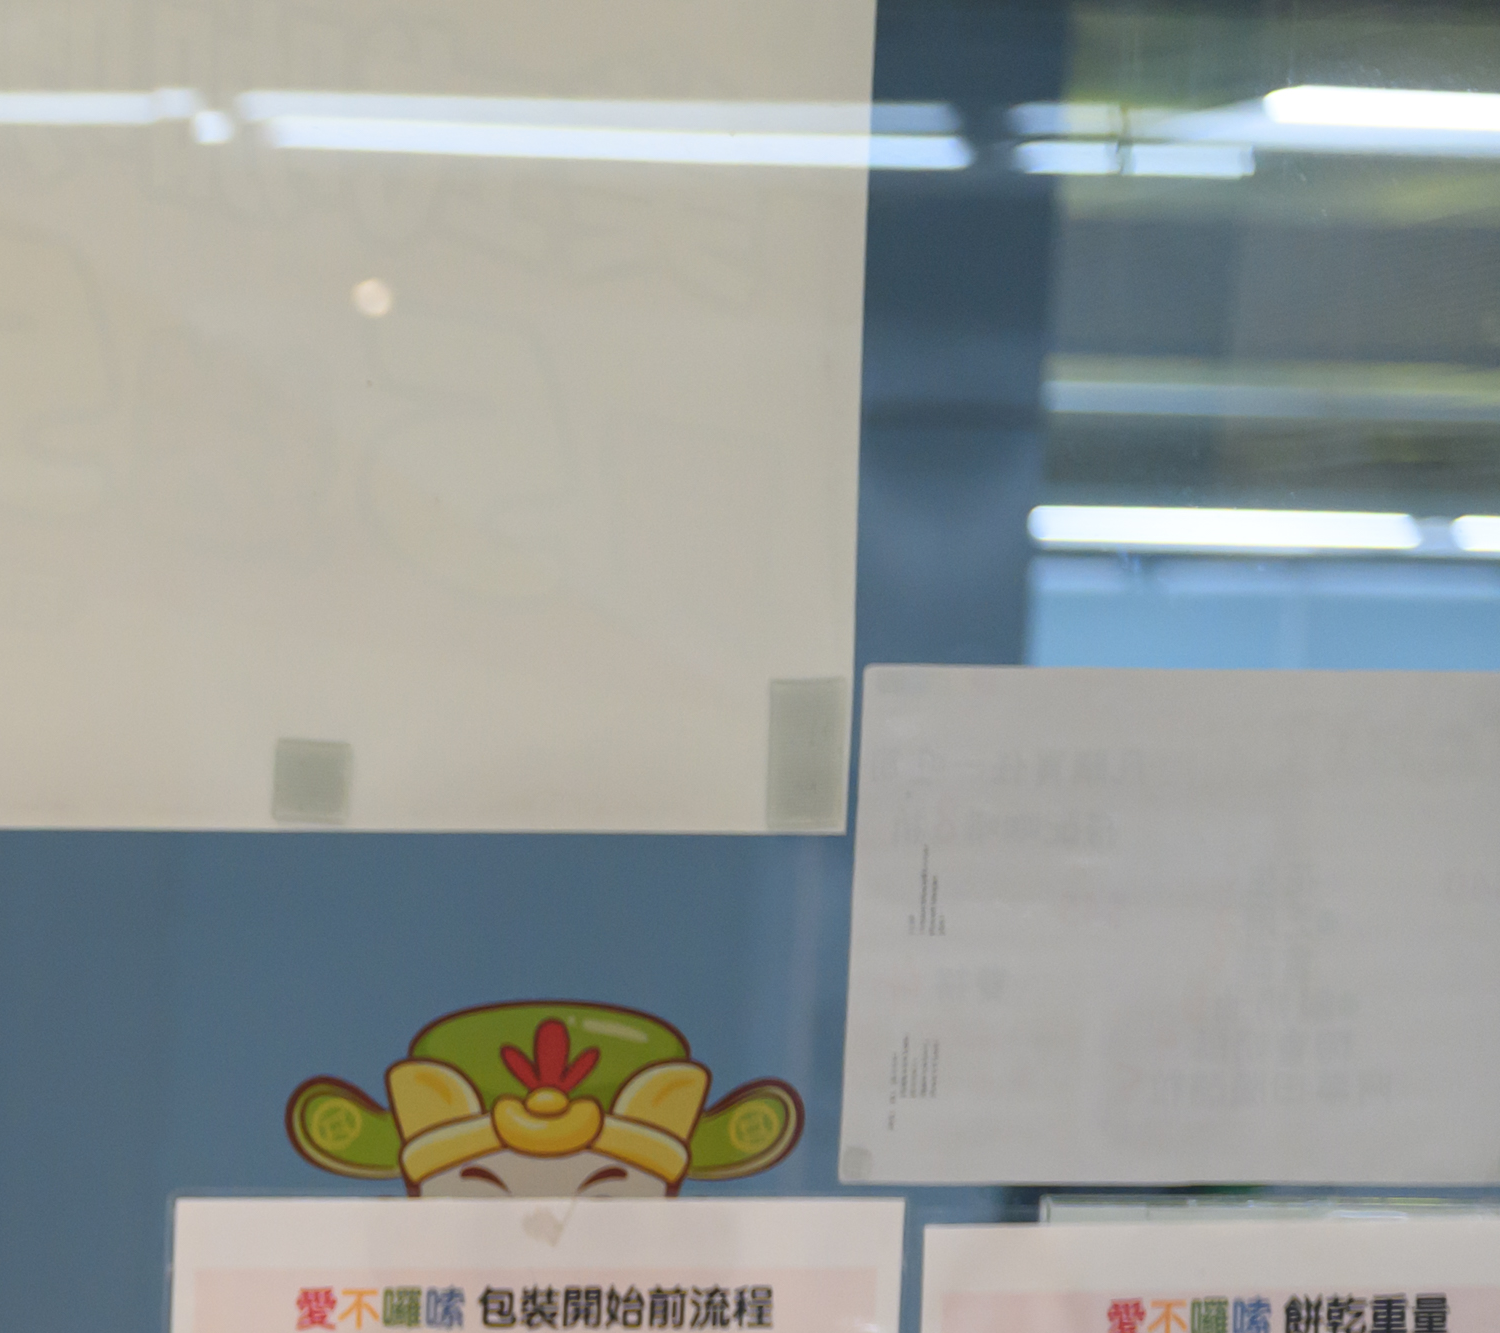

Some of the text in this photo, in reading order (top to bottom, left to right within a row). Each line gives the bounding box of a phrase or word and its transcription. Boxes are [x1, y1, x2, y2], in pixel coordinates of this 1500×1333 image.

[296, 1285, 774, 1332] 愛不囉嗦 包裝開始前流程
